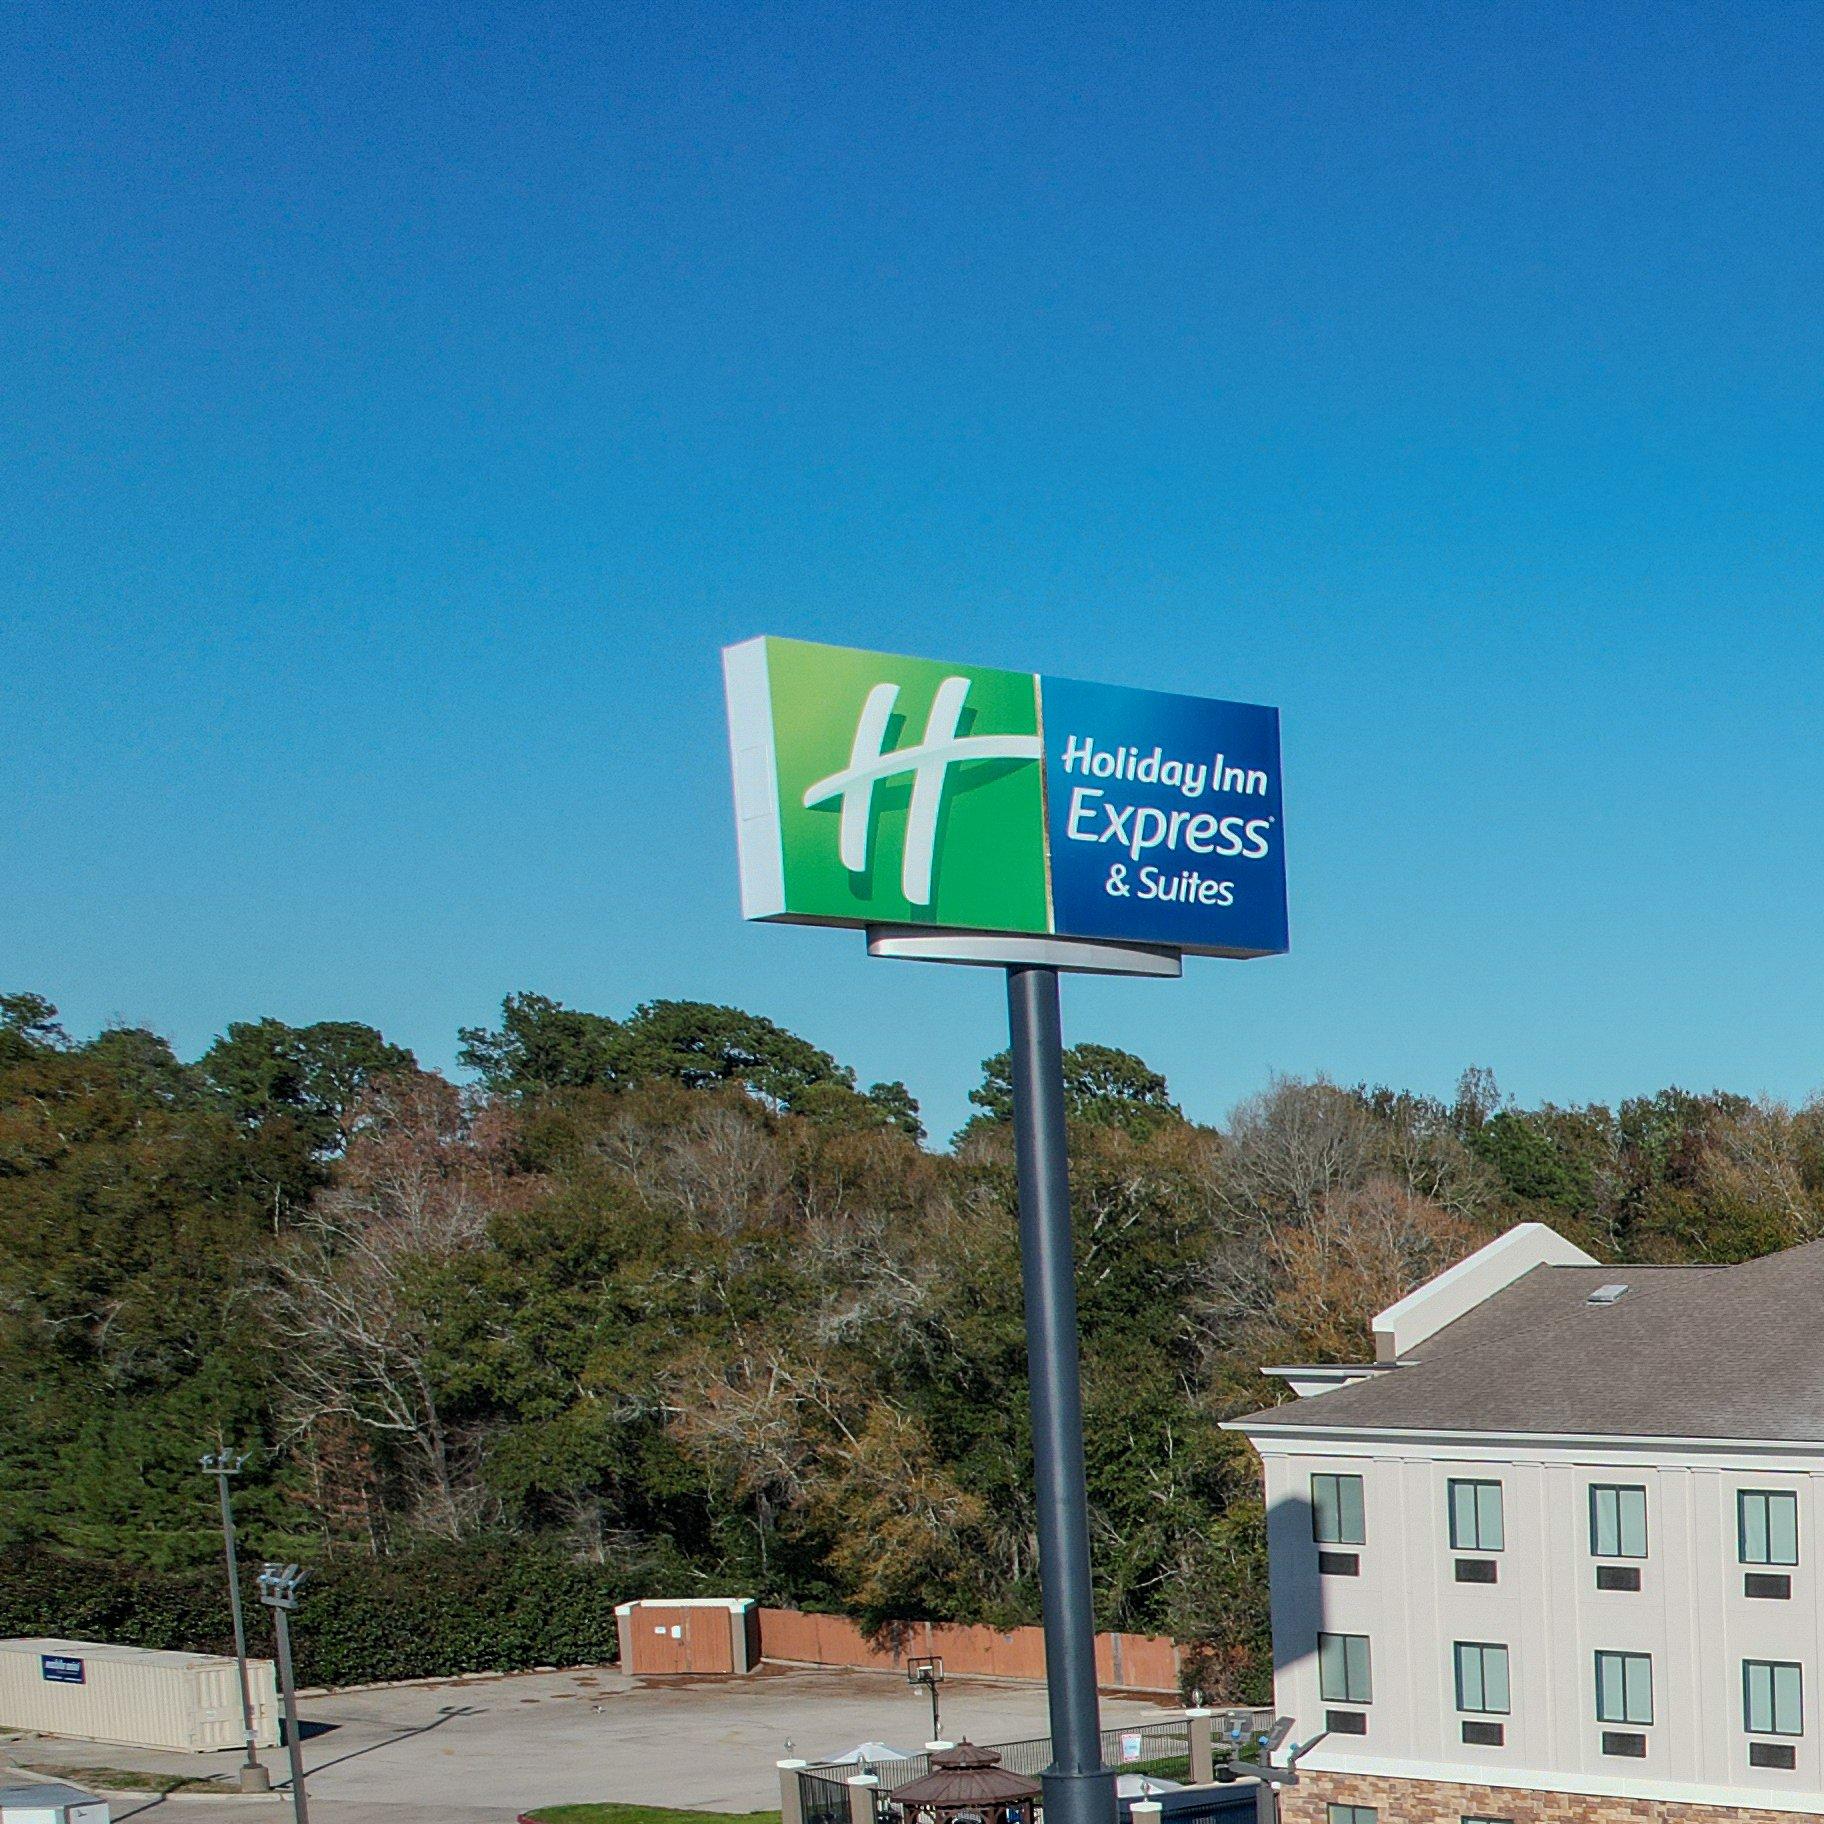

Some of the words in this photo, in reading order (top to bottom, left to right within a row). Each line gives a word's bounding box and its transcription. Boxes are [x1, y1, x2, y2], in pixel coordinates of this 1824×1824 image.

[1061, 735, 1207, 797] Holiday
[1212, 753, 1268, 796] Inn
[1066, 787, 1271, 861] Express
[1105, 863, 1130, 897] &
[1137, 866, 1235, 906] Suites
